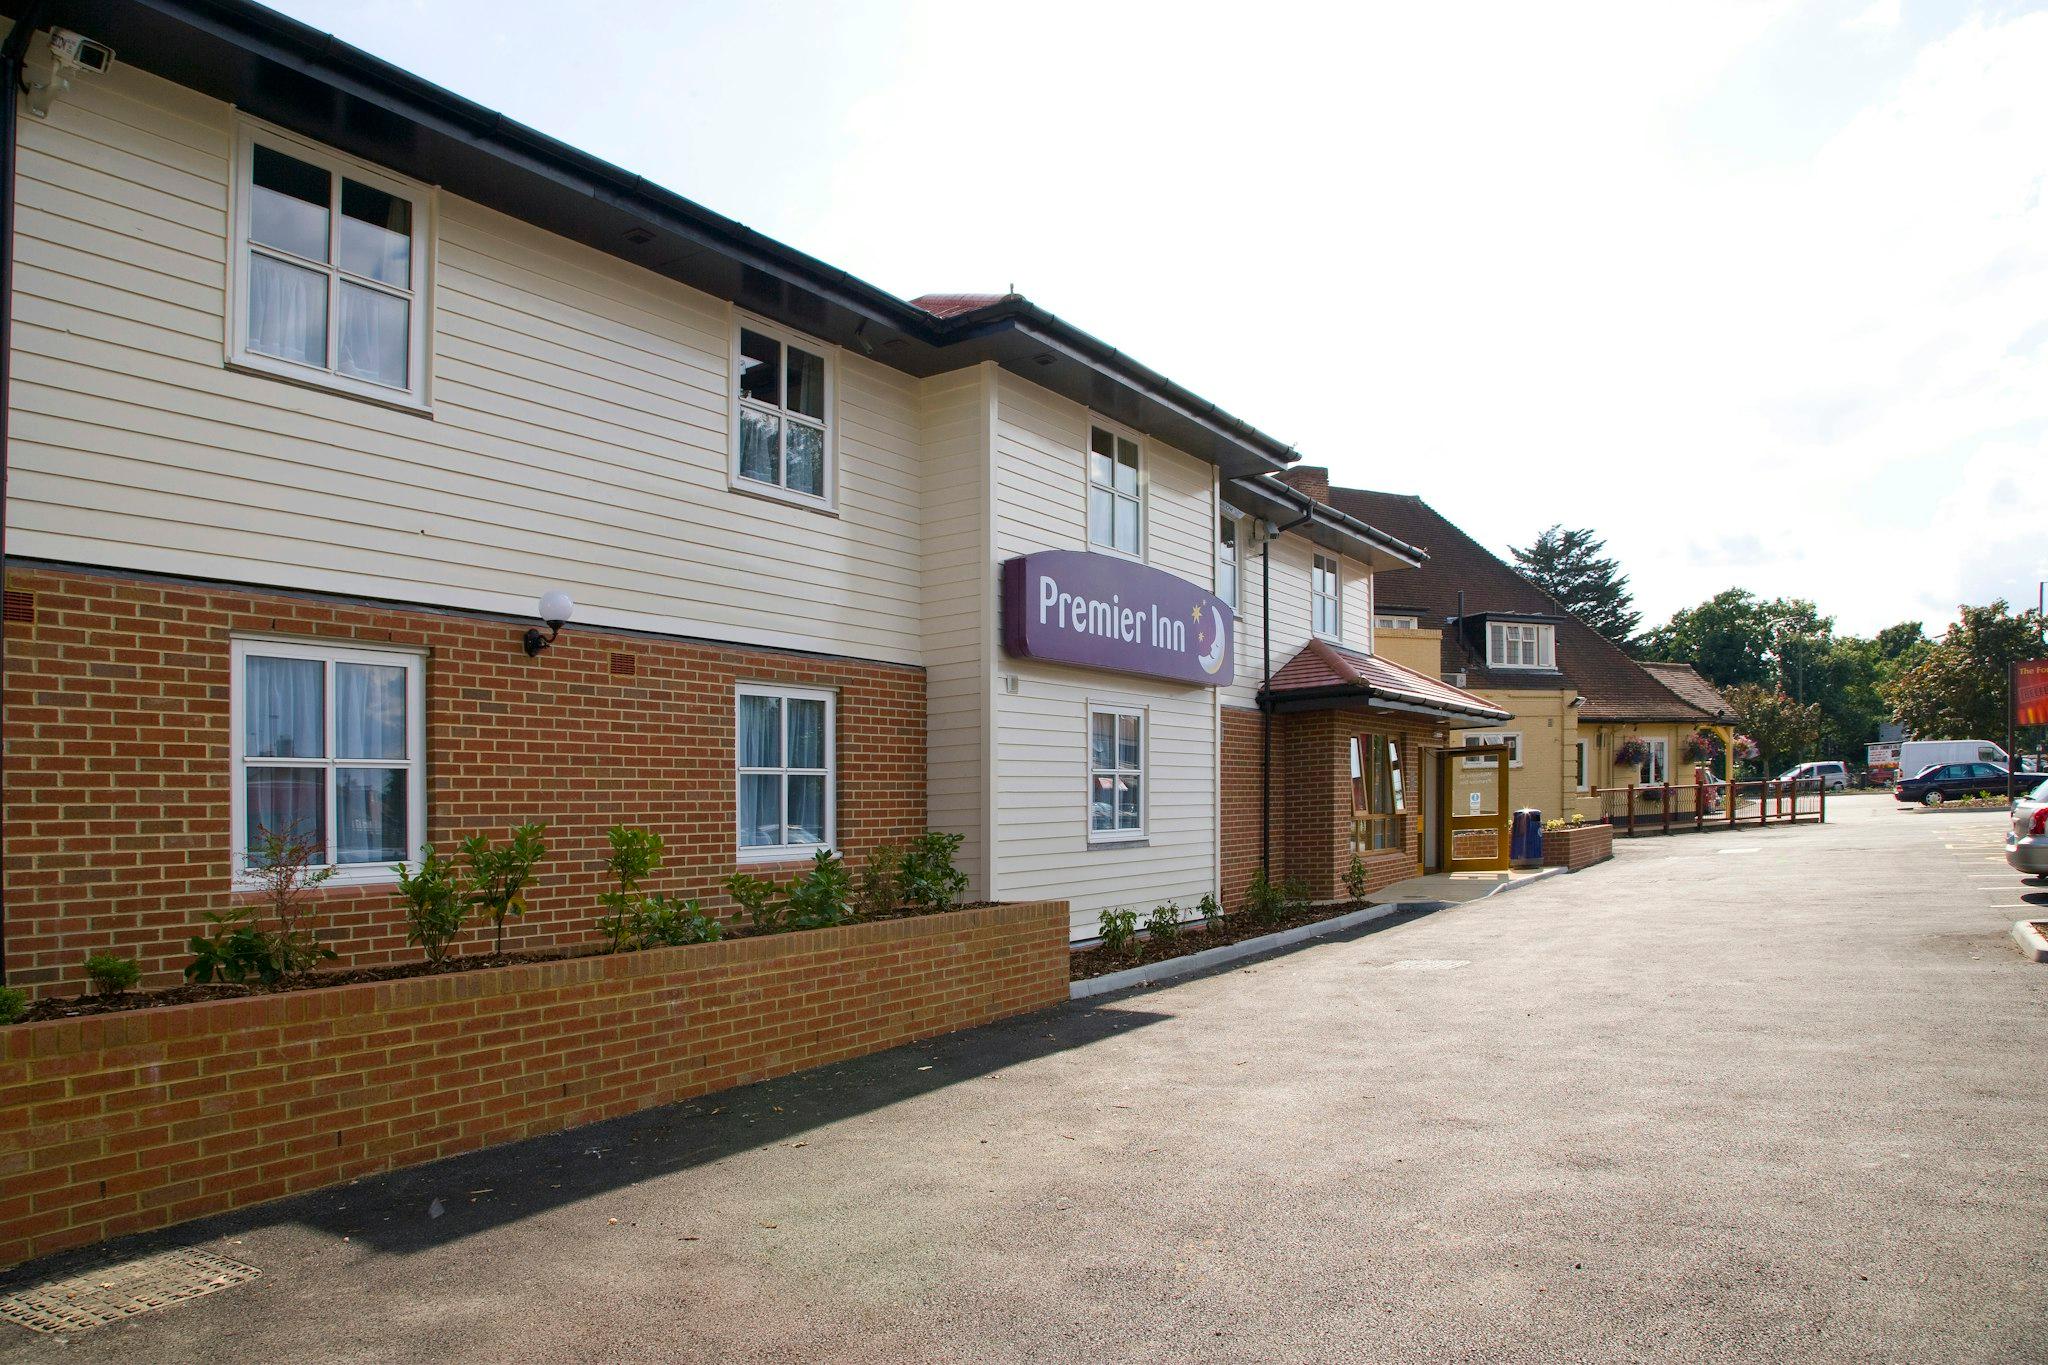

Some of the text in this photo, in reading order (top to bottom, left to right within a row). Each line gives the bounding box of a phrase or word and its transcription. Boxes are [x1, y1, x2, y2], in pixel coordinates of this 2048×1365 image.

[1040, 576, 1185, 652] Premier Inn
[2019, 667, 2034, 675] The
